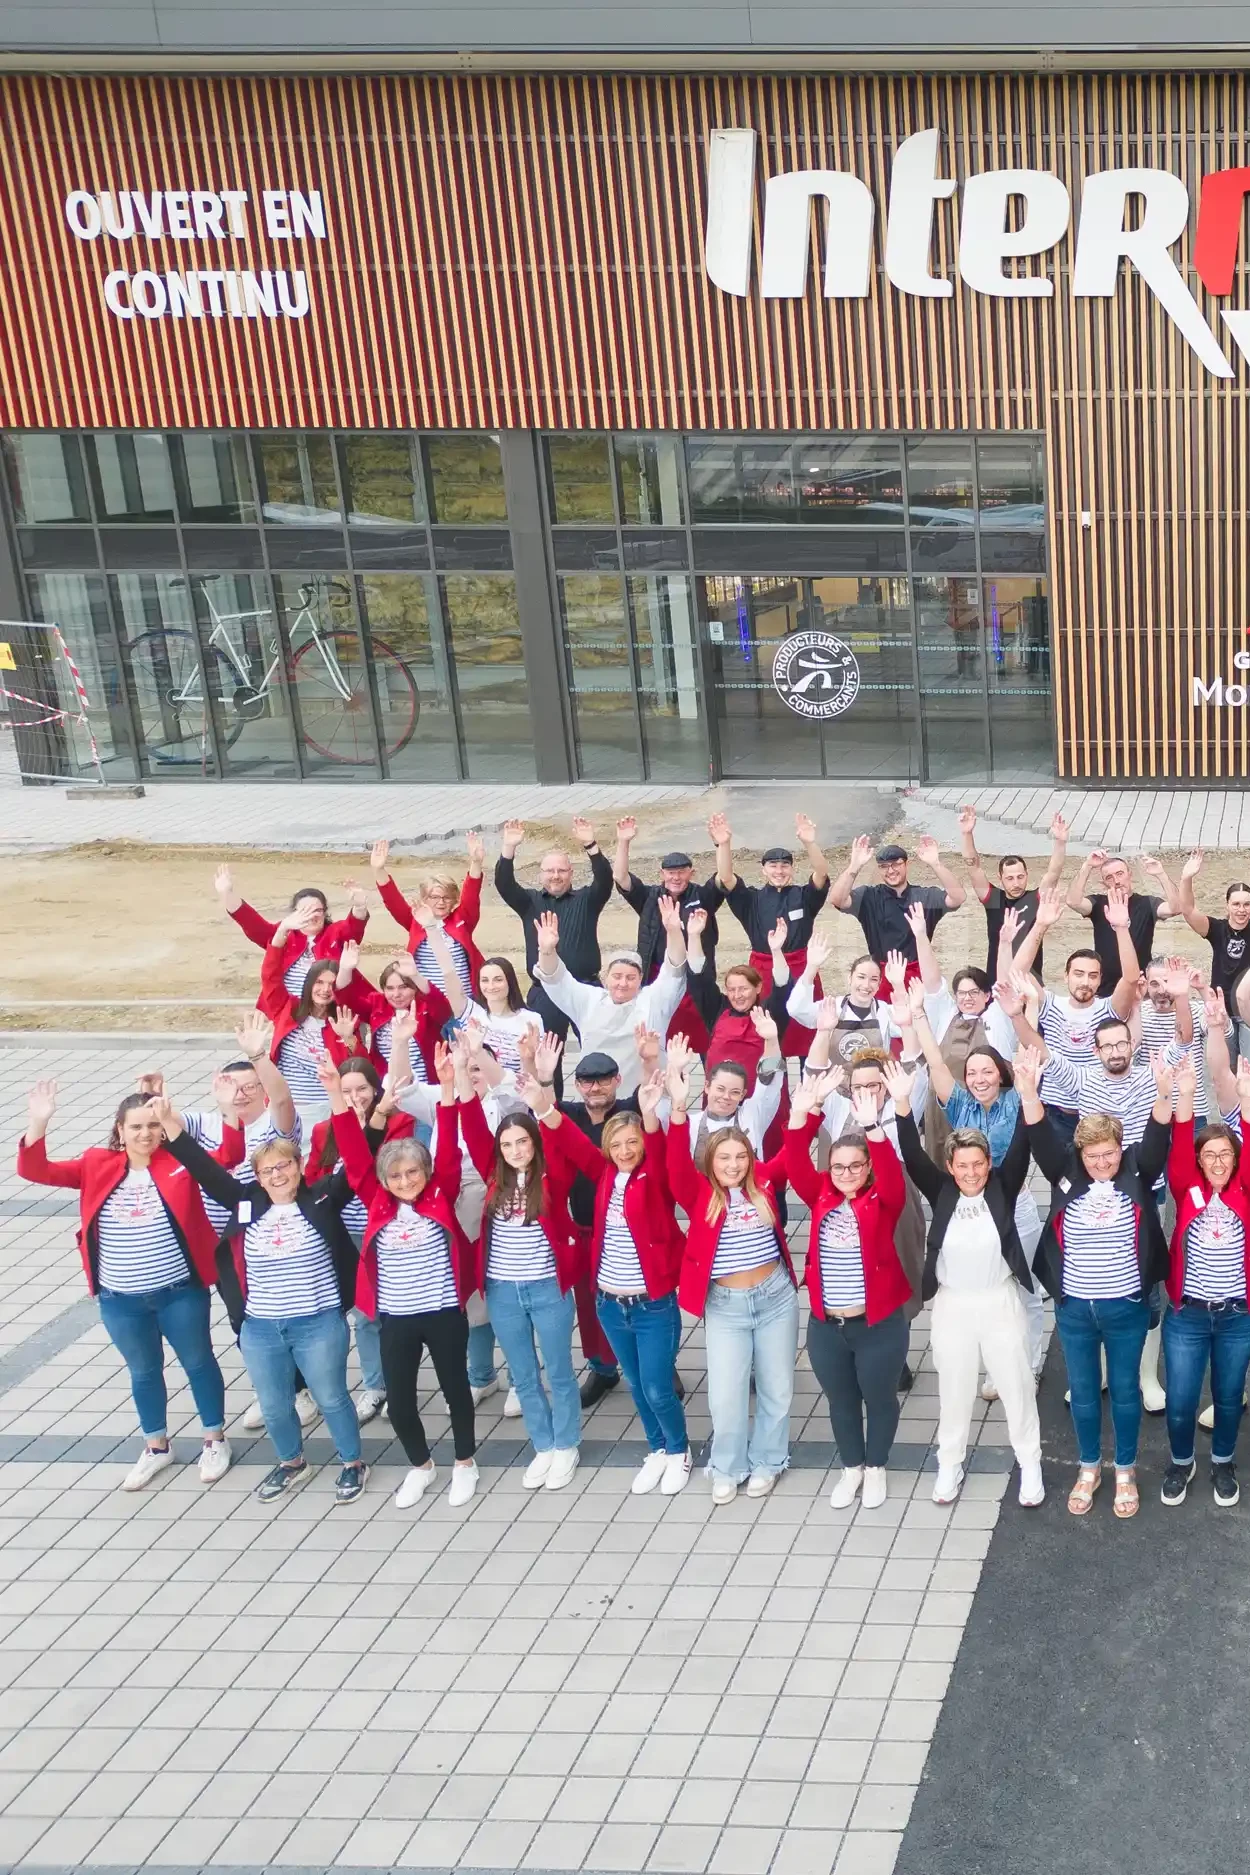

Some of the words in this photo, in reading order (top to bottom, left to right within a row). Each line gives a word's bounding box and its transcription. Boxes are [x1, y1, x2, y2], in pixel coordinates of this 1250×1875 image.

[65, 188, 249, 241] OUVERT
[263, 189, 327, 240] EN
[103, 269, 312, 320] CONTINU
[776, 634, 842, 679] PRODUCTEURS
[788, 671, 857, 716] COMMERÇANTS
